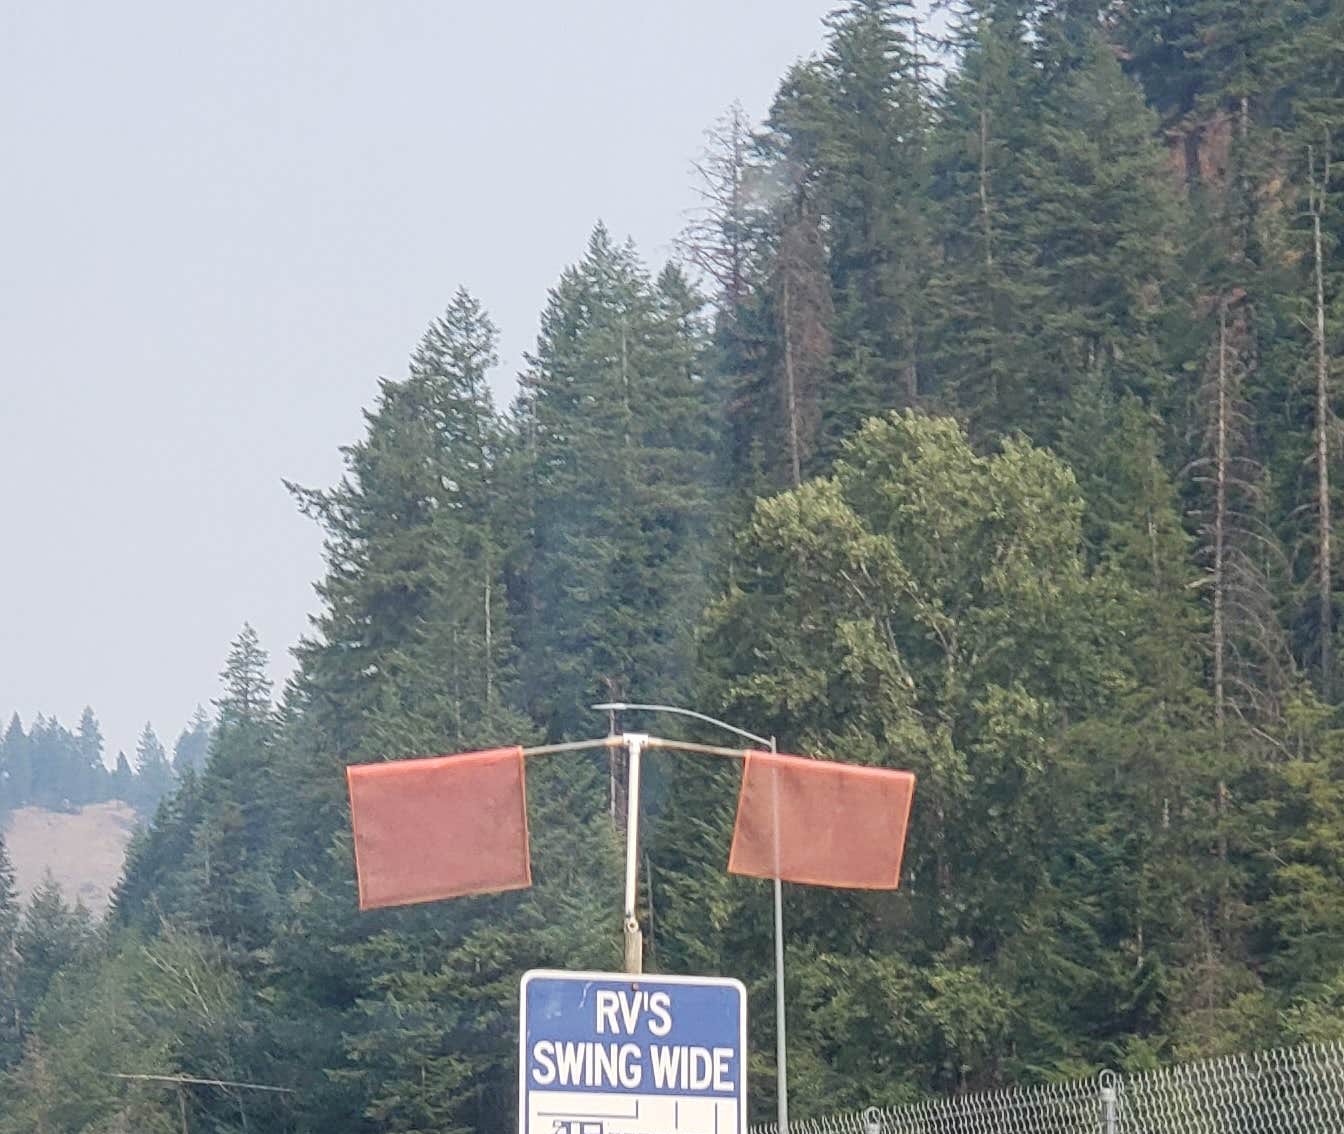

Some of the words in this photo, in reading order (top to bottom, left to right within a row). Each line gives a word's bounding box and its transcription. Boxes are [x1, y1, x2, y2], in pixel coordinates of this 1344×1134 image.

[596, 990, 672, 1037] RV'S
[532, 1040, 642, 1089] SWING
[650, 1045, 735, 1092] WIDE
